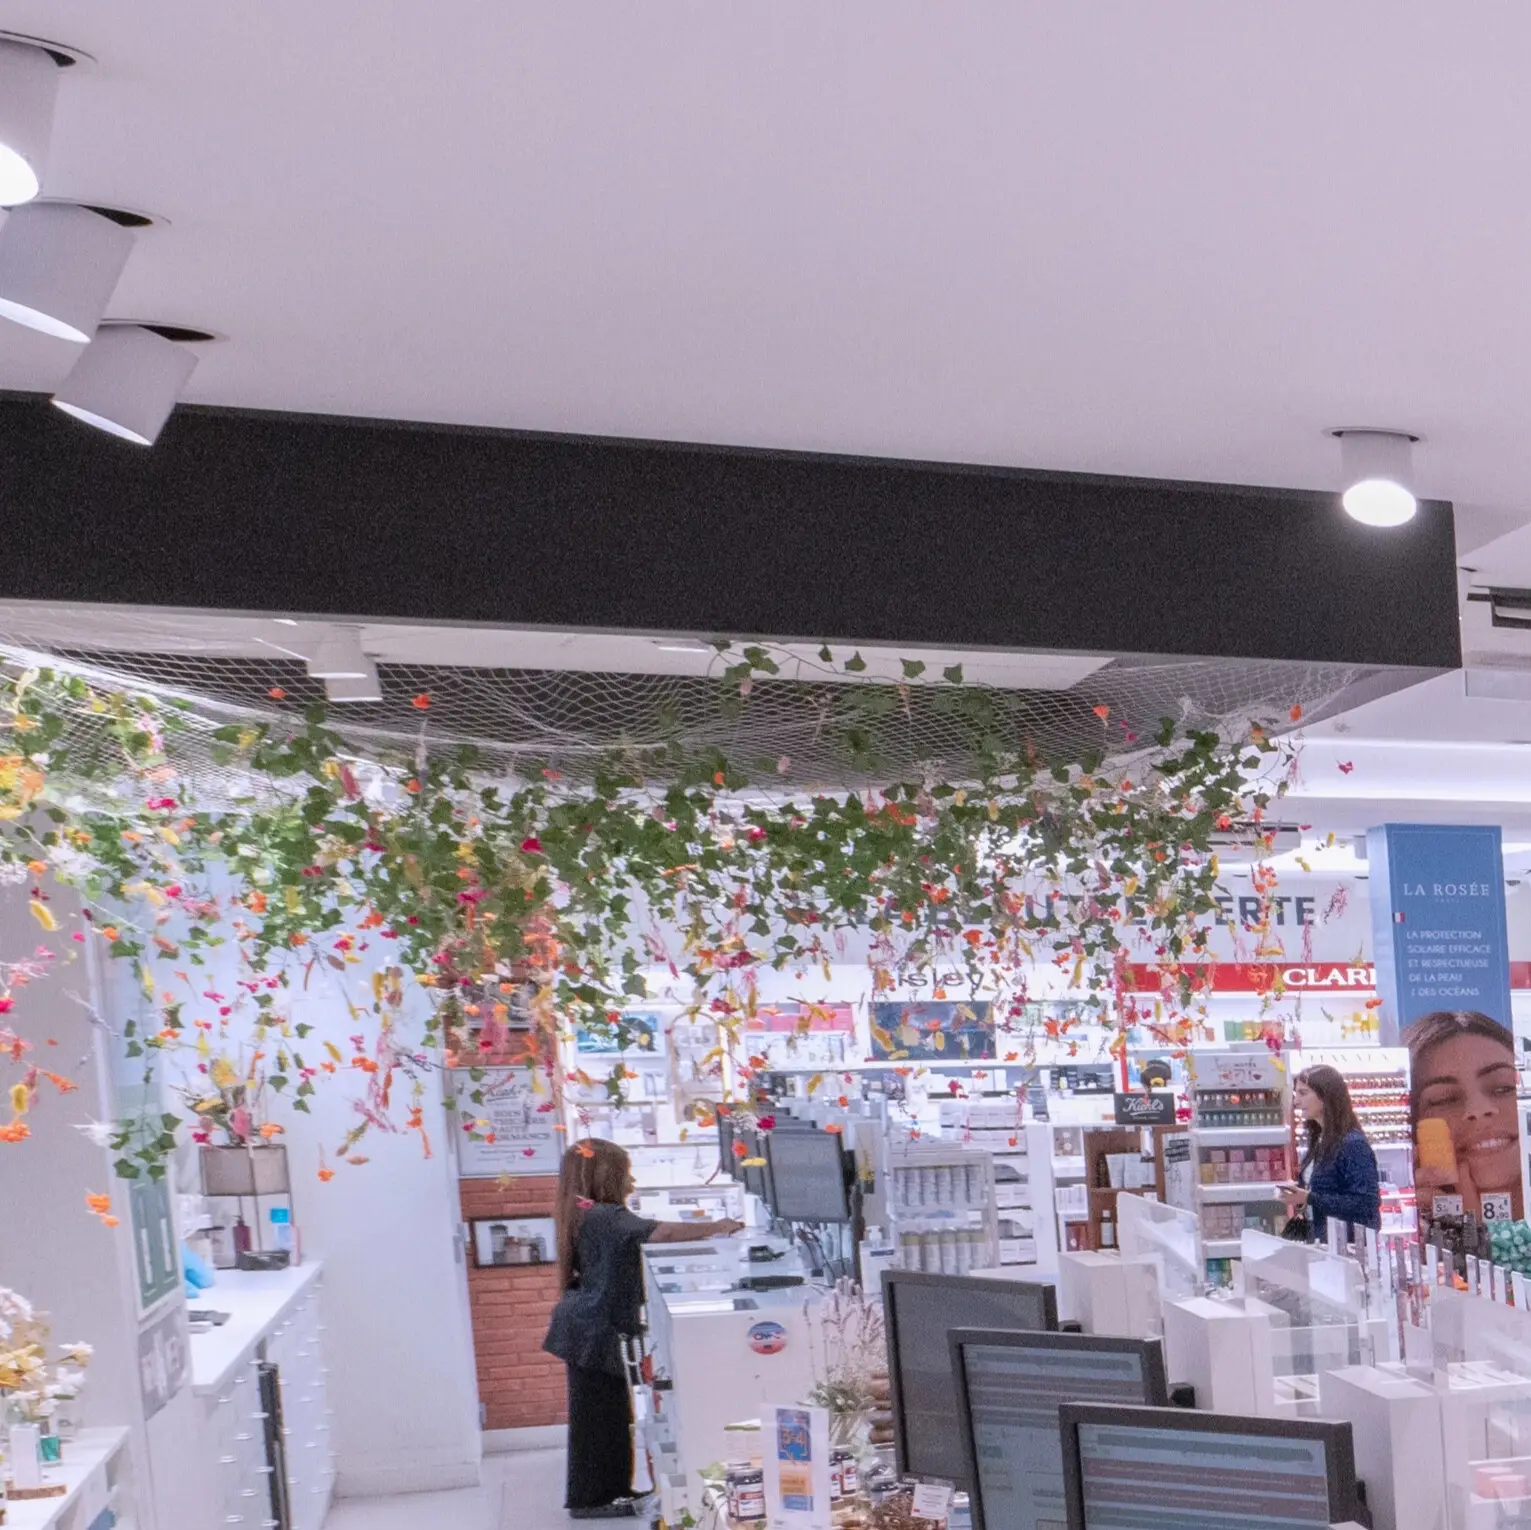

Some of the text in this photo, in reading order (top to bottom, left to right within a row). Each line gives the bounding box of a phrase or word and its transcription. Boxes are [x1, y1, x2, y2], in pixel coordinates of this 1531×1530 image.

[1404, 881, 1490, 896] LA ROSÉE
[1406, 930, 1482, 940] LA PROTECTION
[1407, 944, 1492, 954] SOLAIRE EFFICACE
[1421, 959, 1489, 968] RESPECTUEUSE
[1424, 973, 1462, 982] LA PEAU
[1418, 986, 1480, 996] DES OCÉANS
